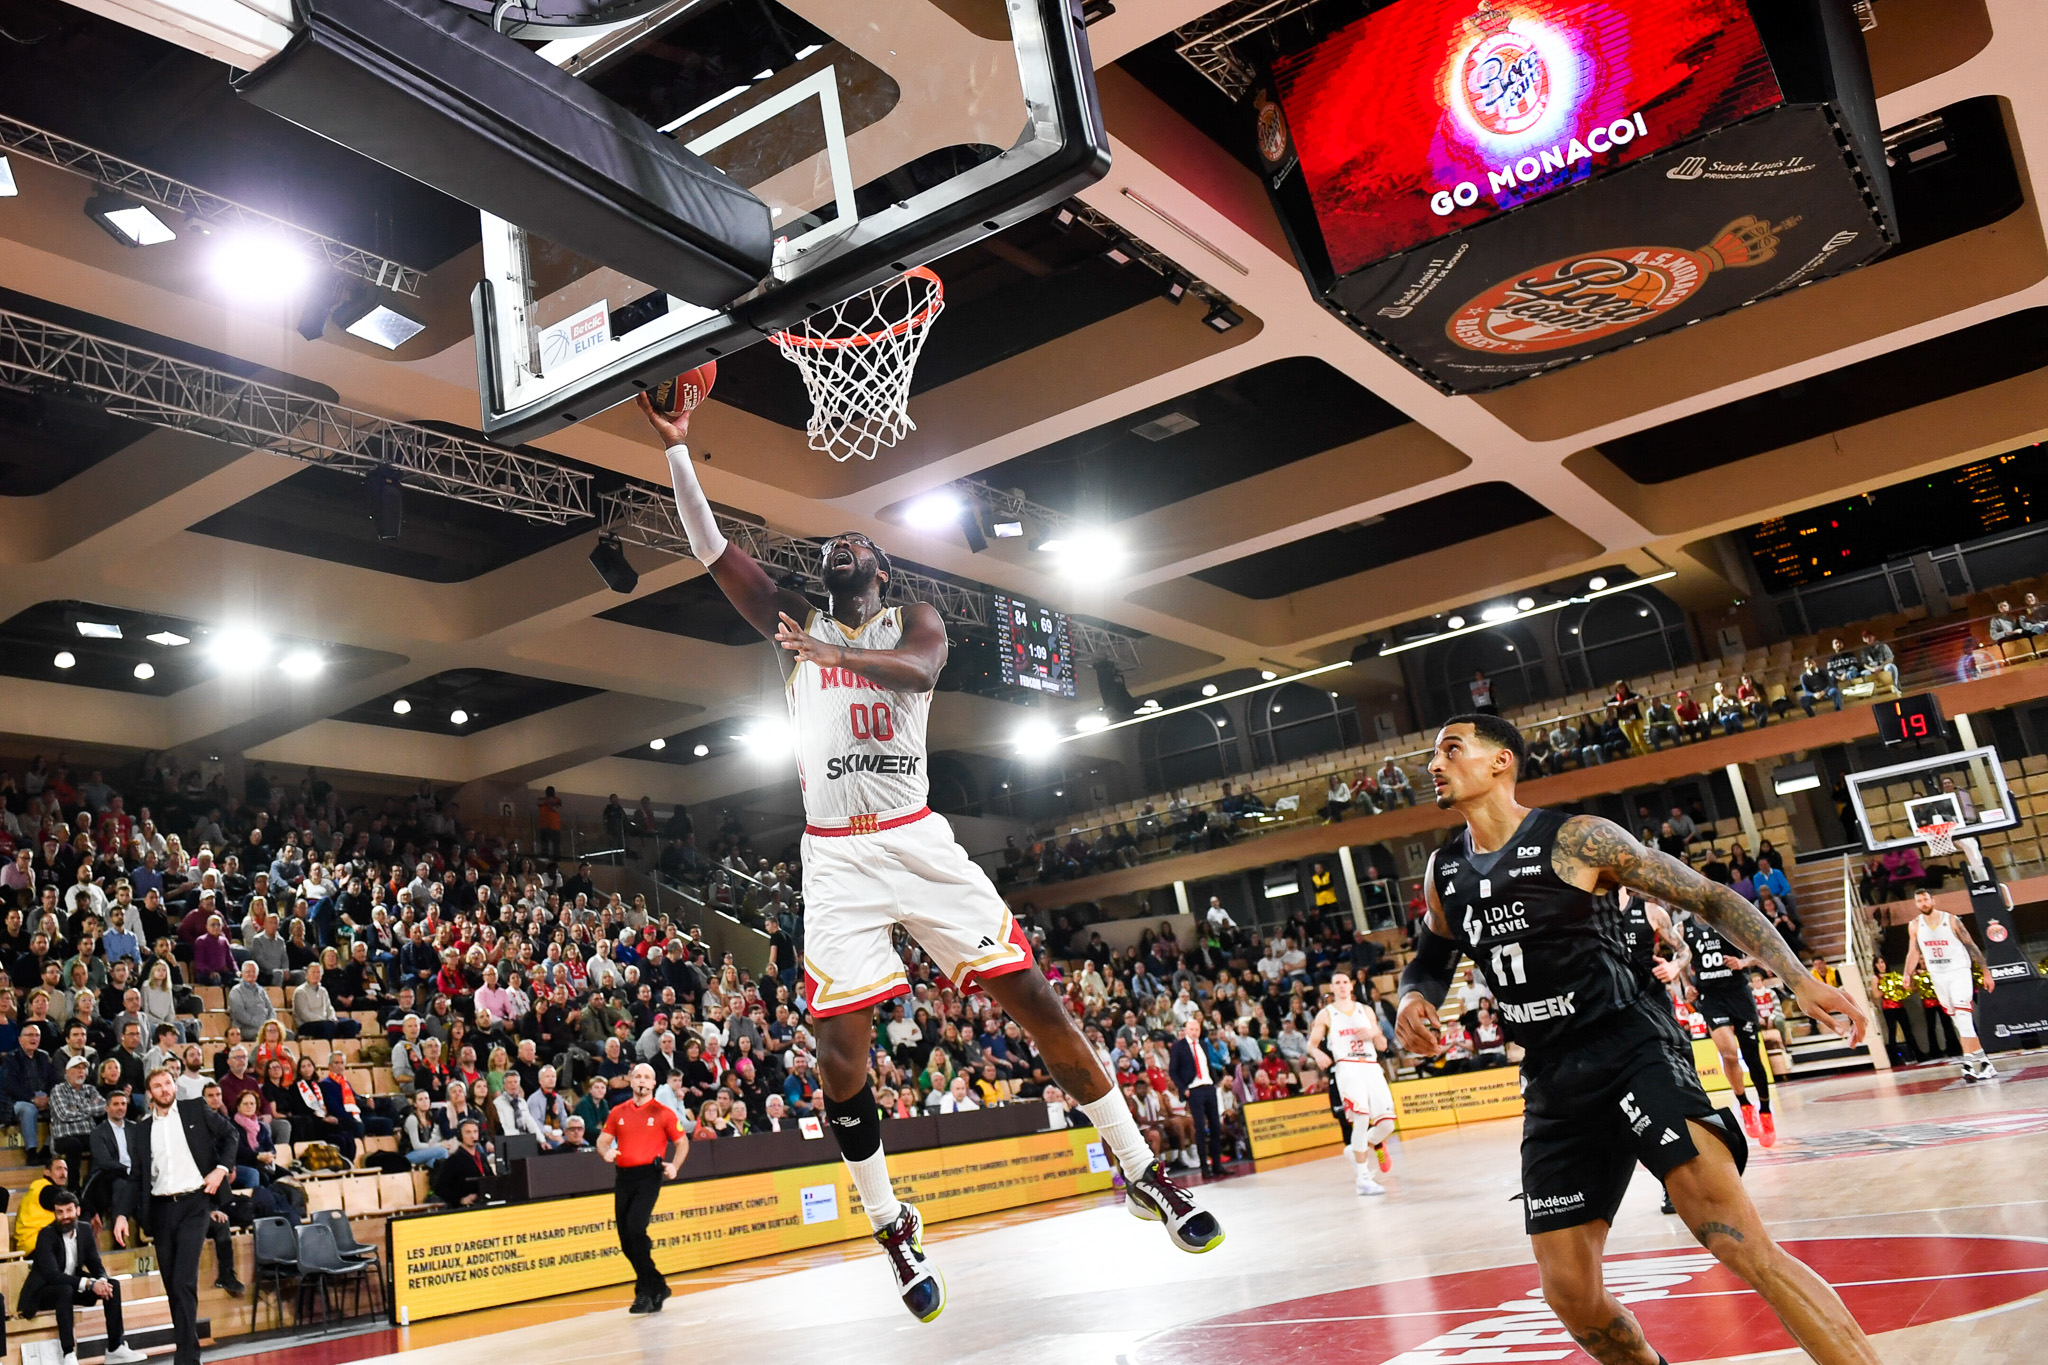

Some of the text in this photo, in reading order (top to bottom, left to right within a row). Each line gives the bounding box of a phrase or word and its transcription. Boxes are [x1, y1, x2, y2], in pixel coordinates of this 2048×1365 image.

[1709, 161, 1748, 172] Stade
[1748, 159, 1786, 171] Louis
[1778, 164, 1816, 176] MONACO
[1430, 181, 1479, 216] GO
[1411, 268, 1438, 295] Louis
[573, 315, 602, 337] Betclic
[1456, 318, 1510, 350] BASKET
[575, 331, 604, 354] ÉLITE
[1014, 609, 1028, 627] 84
[1040, 617, 1052, 634] 69
[1028, 643, 1047, 660] 1:09
[849, 702, 895, 741] 00
[1901, 713, 1928, 738] 19
[826, 753, 921, 780] SKWEEK
[1517, 846, 1541, 856] DCB
[1484, 901, 1525, 924] LDLC
[1490, 918, 1529, 936] ASVEL
[1701, 951, 1724, 969] 00
[1932, 947, 1944, 958] 20
[1490, 942, 1527, 987] 11
[1350, 1039, 1365, 1052] 22
[681, 1207, 708, 1219] PERTES
[746, 1196, 779, 1209] CONFLITS
[1538, 1191, 1585, 1209] Adéquat
[407, 1219, 617, 1260] LES JEUX D'ARGENT ET DE HASARD PEUVENT ÊT
[682, 1234, 690, 1244] 74
[693, 1232, 701, 1242] 75
[703, 1230, 711, 1240] 13
[713, 1228, 722, 1239] 13
[728, 1224, 750, 1236] APPEL
[752, 1222, 766, 1231] NON
[138, 1257, 150, 1273] 02
[408, 1257, 464, 1275] FAMILIAUX,
[409, 1246, 622, 1289] RETROUVEZ NOS CONSEILS SUR JOUEURS-INFO-
